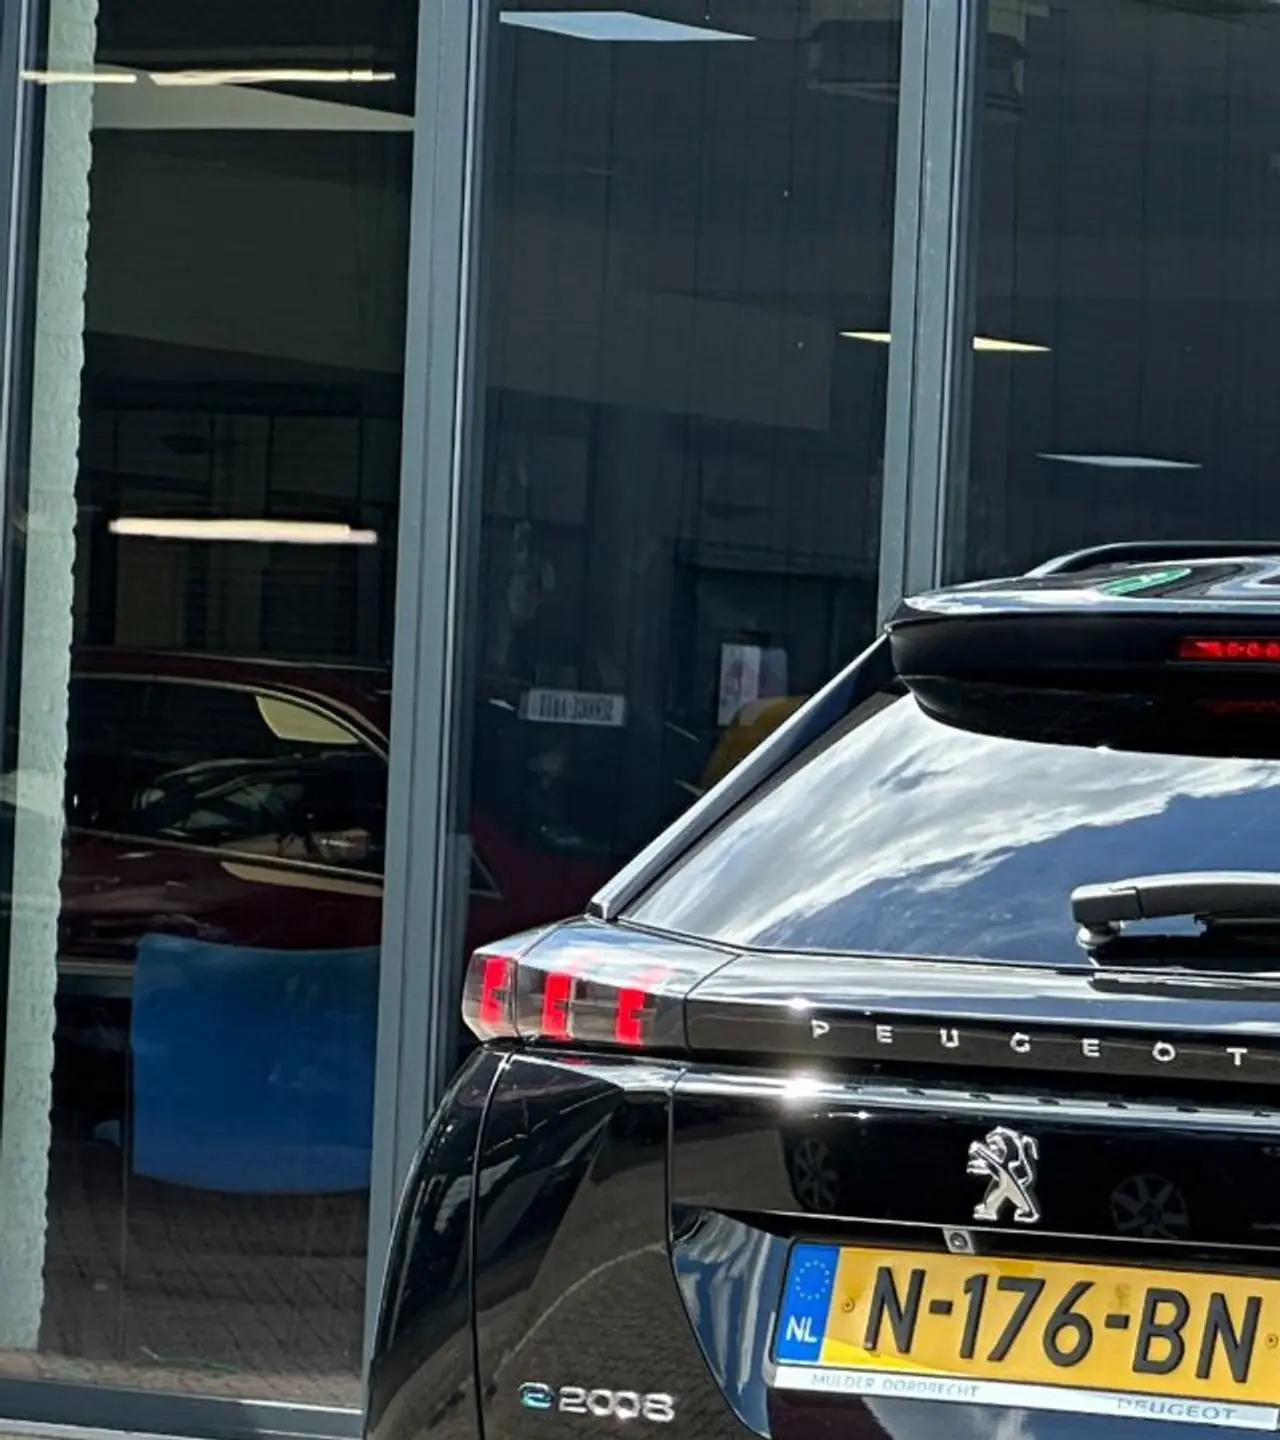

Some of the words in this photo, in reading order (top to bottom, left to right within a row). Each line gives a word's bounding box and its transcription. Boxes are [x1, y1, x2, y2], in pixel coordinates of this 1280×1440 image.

[810, 1019, 1248, 1066] PEUGEOT
[785, 1317, 818, 1344] NL
[863, 1265, 1263, 1383] N-176-BN
[558, 1385, 676, 1423] 2008
[1116, 1396, 1239, 1422] PEUGEOT
